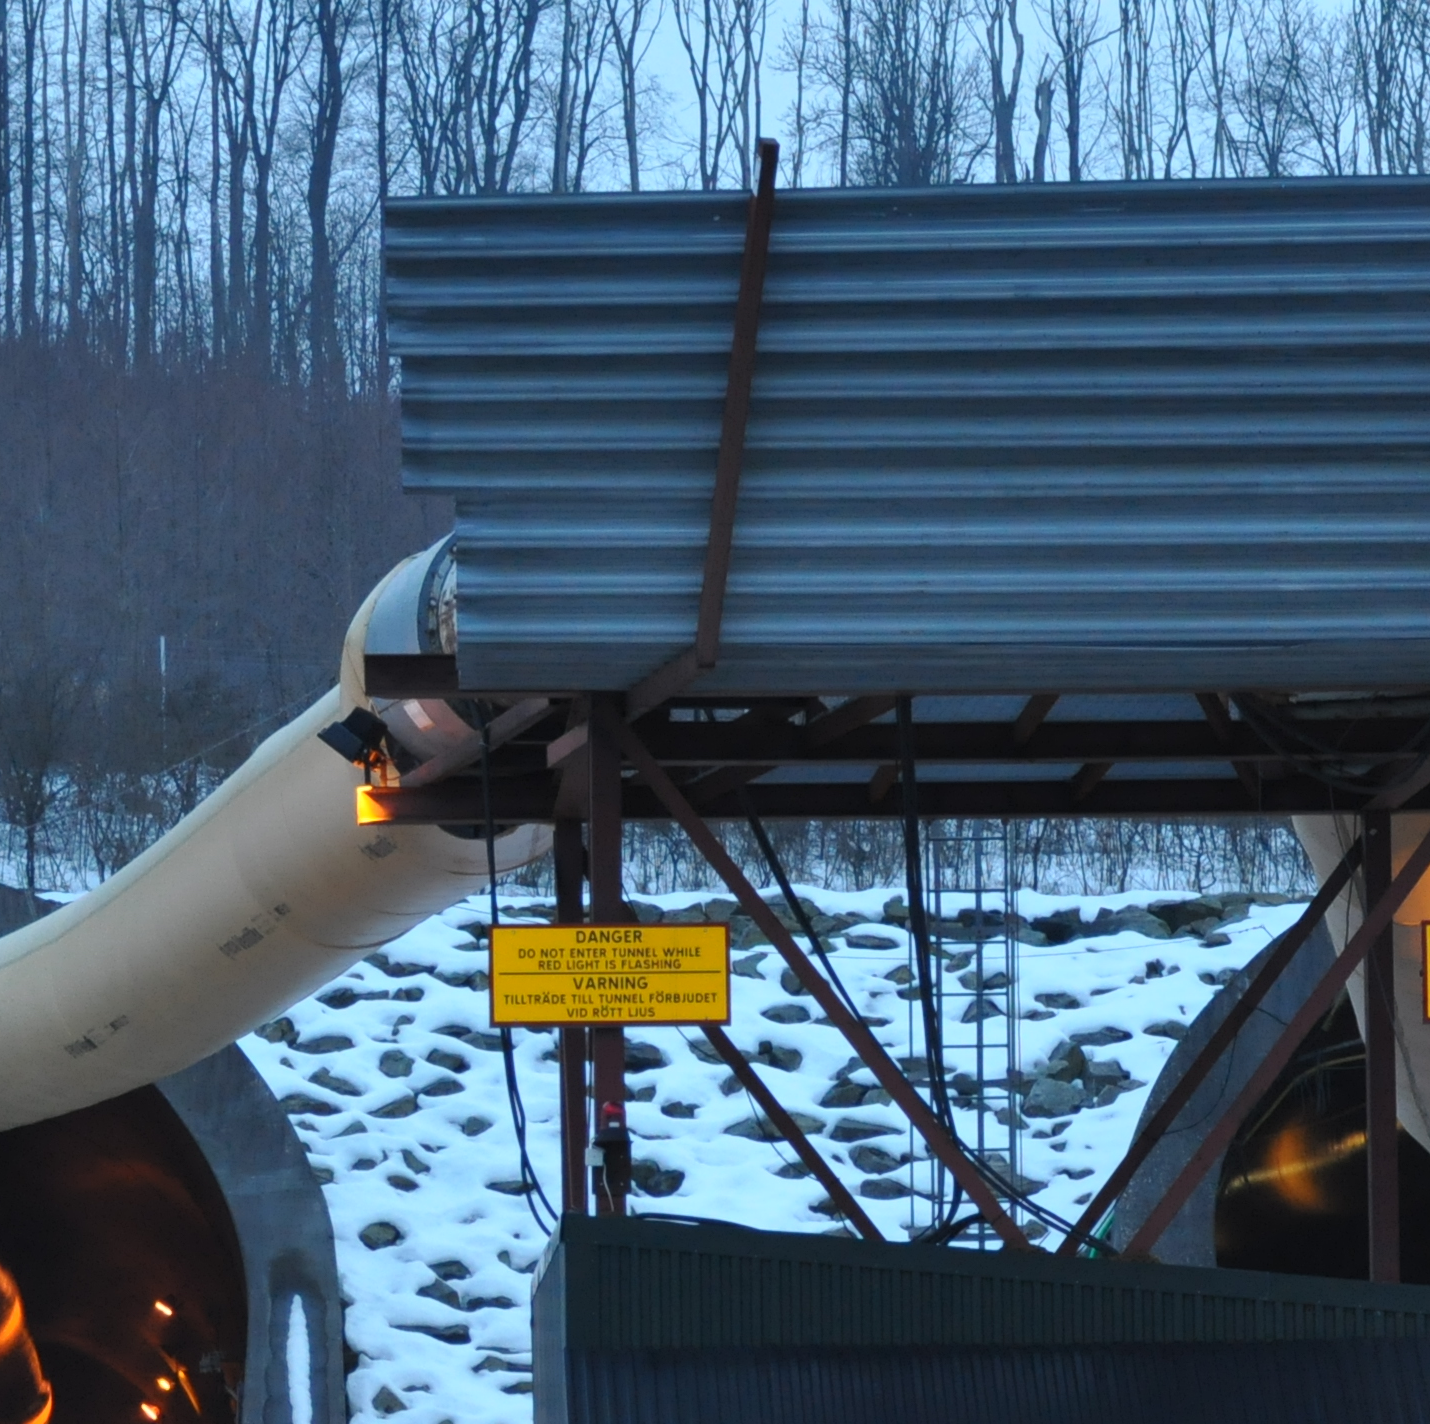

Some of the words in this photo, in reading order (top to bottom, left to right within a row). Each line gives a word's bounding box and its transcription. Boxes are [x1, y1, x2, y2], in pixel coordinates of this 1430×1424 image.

[576, 930, 643, 944] DANGER
[518, 948, 536, 959] DO
[541, 948, 565, 959] NOT
[570, 948, 607, 958] ENTER
[612, 948, 658, 958] TUNNEL
[663, 947, 701, 958] WHILE
[538, 960, 562, 971] RED
[567, 960, 600, 970] LIGHT
[605, 960, 616, 970] IS
[621, 959, 682, 970] FLASHING
[573, 976, 648, 990] VARNING
[504, 992, 566, 1005] TILLTRÄDE
[571, 994, 594, 1004] TILL
[598, 993, 645, 1004] TUNNEL
[649, 991, 717, 1004] FÖRBJUDET
[566, 1007, 587, 1018] VID
[593, 1005, 623, 1018] RÖTT
[628, 1007, 655, 1017] LJUS
